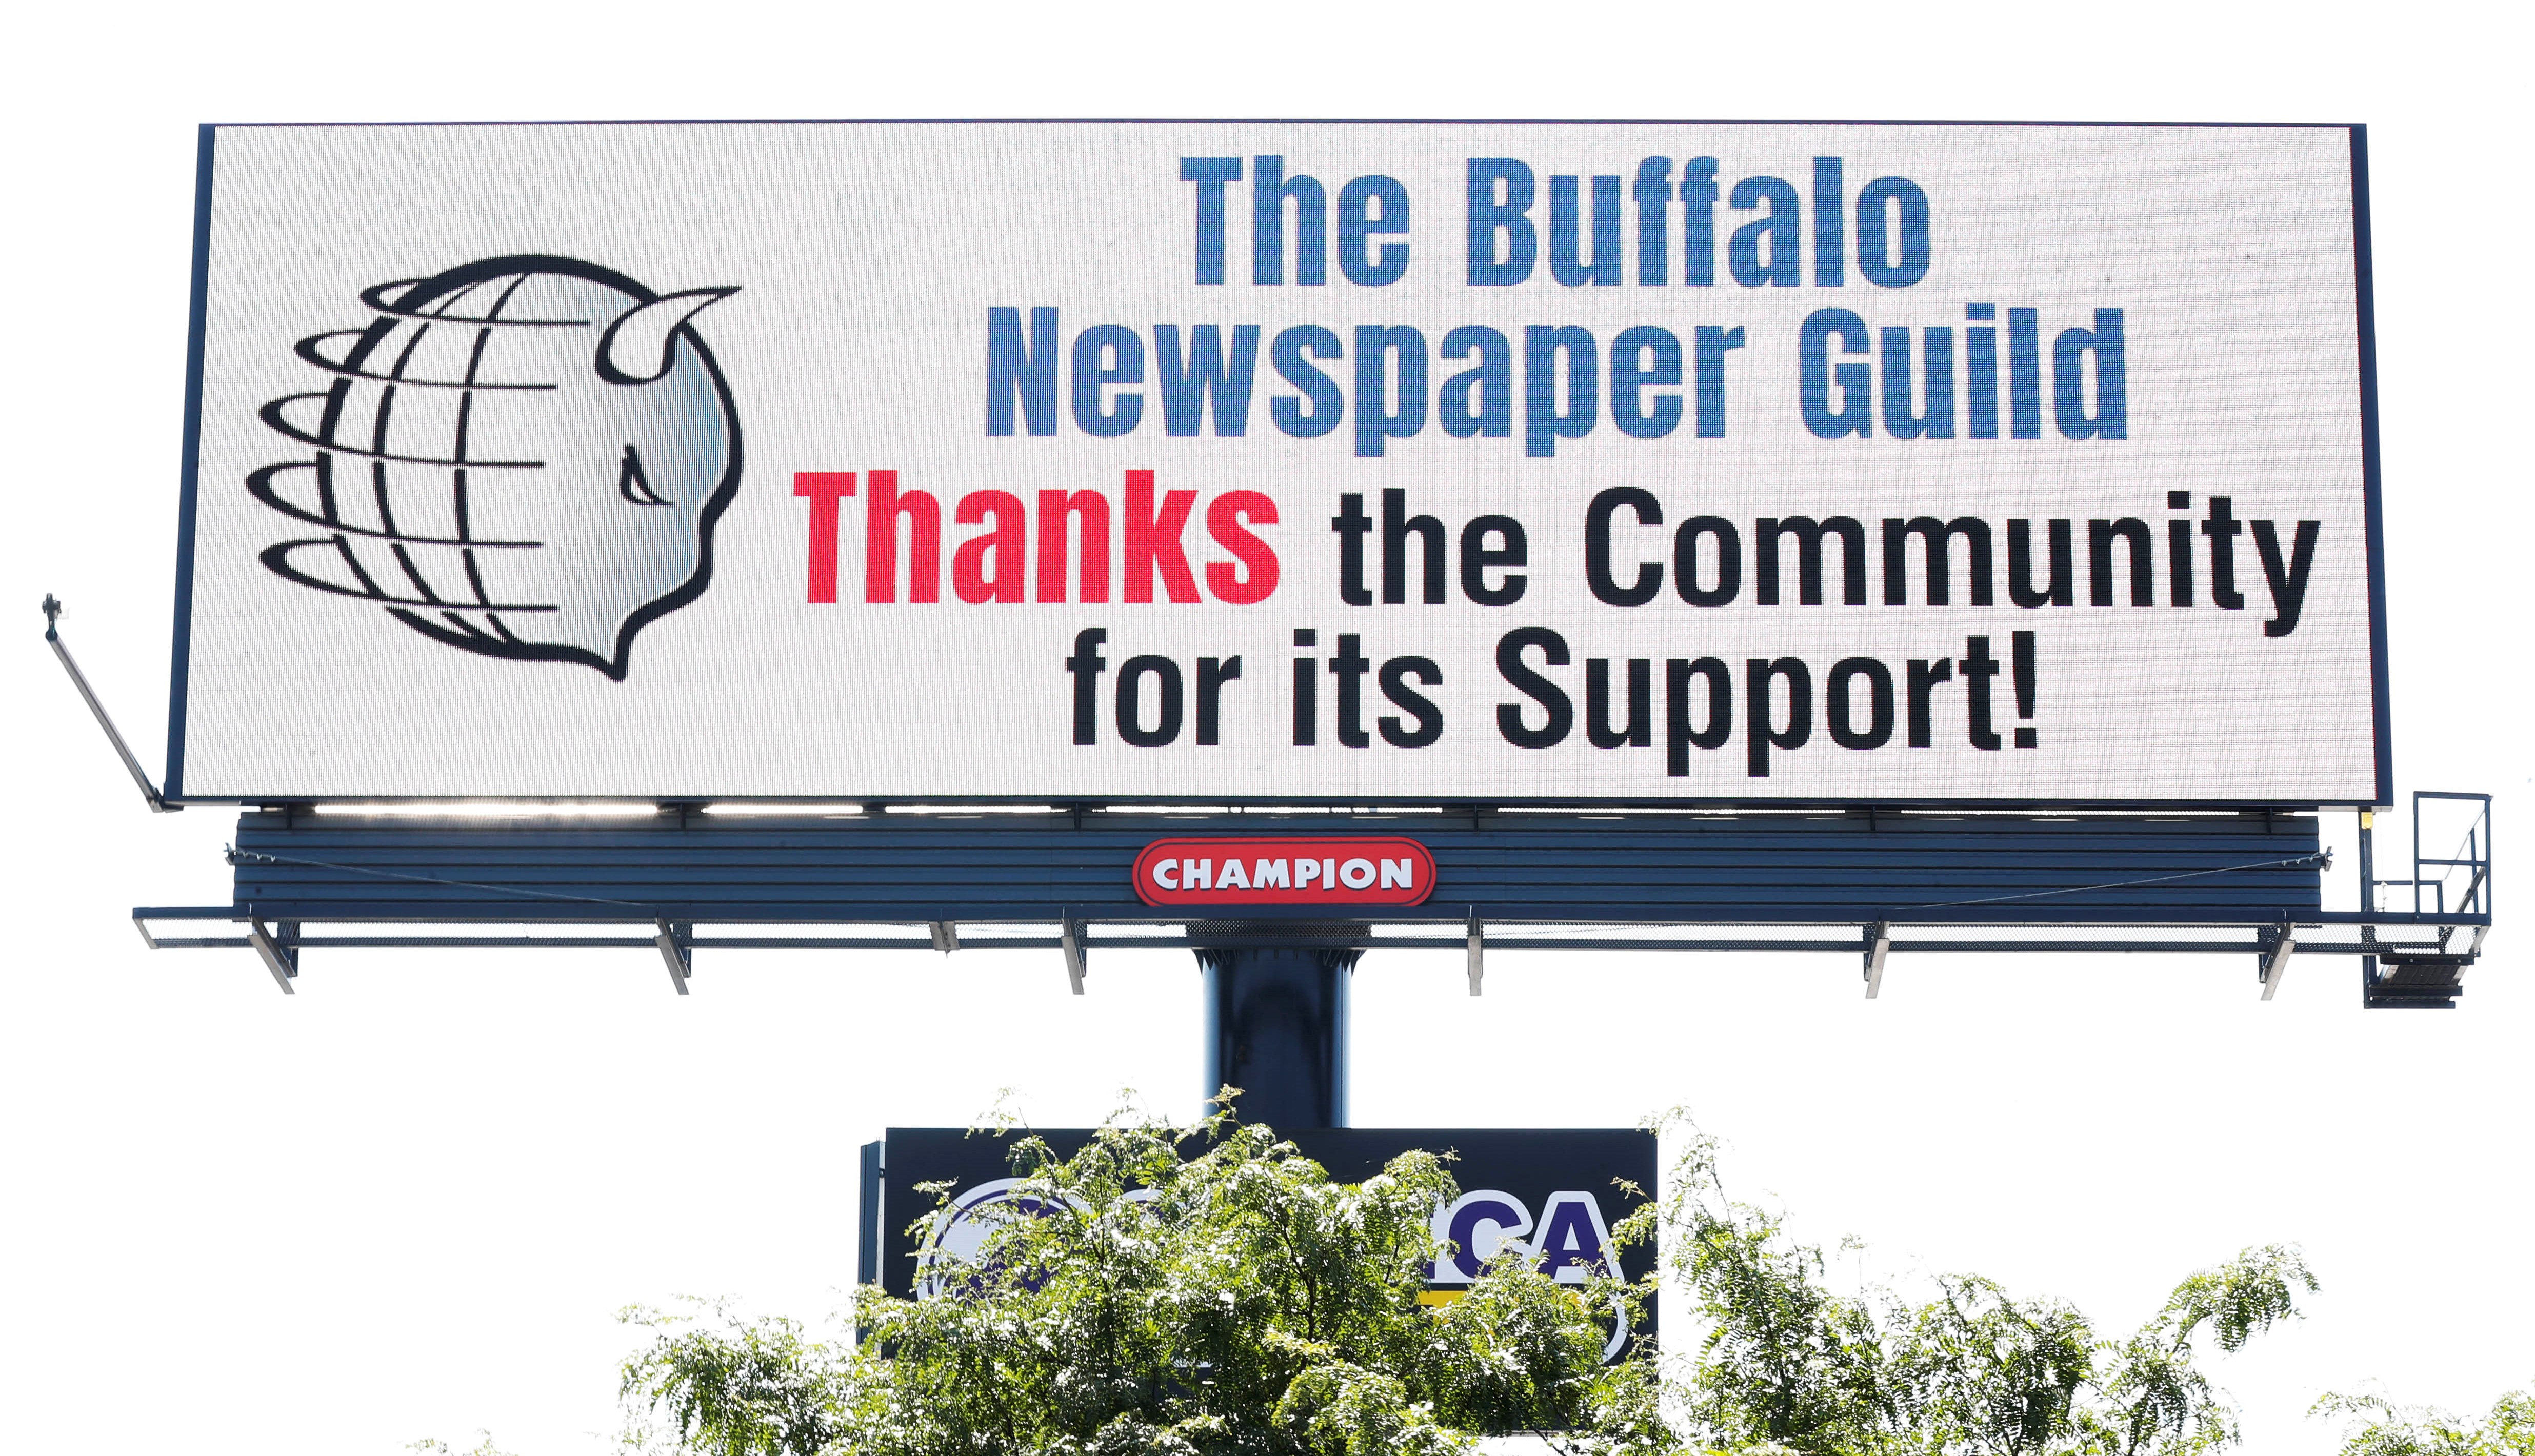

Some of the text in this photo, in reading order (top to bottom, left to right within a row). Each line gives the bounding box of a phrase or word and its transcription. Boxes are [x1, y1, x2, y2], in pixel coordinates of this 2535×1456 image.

[1181, 155, 1930, 288] The Buffalo
[988, 303, 2127, 457] Newspaper Guild
[793, 469, 2320, 638] Thanks the Community
[1066, 626, 2038, 778] for its Support!
[1153, 858, 1412, 891] CHAMPION
